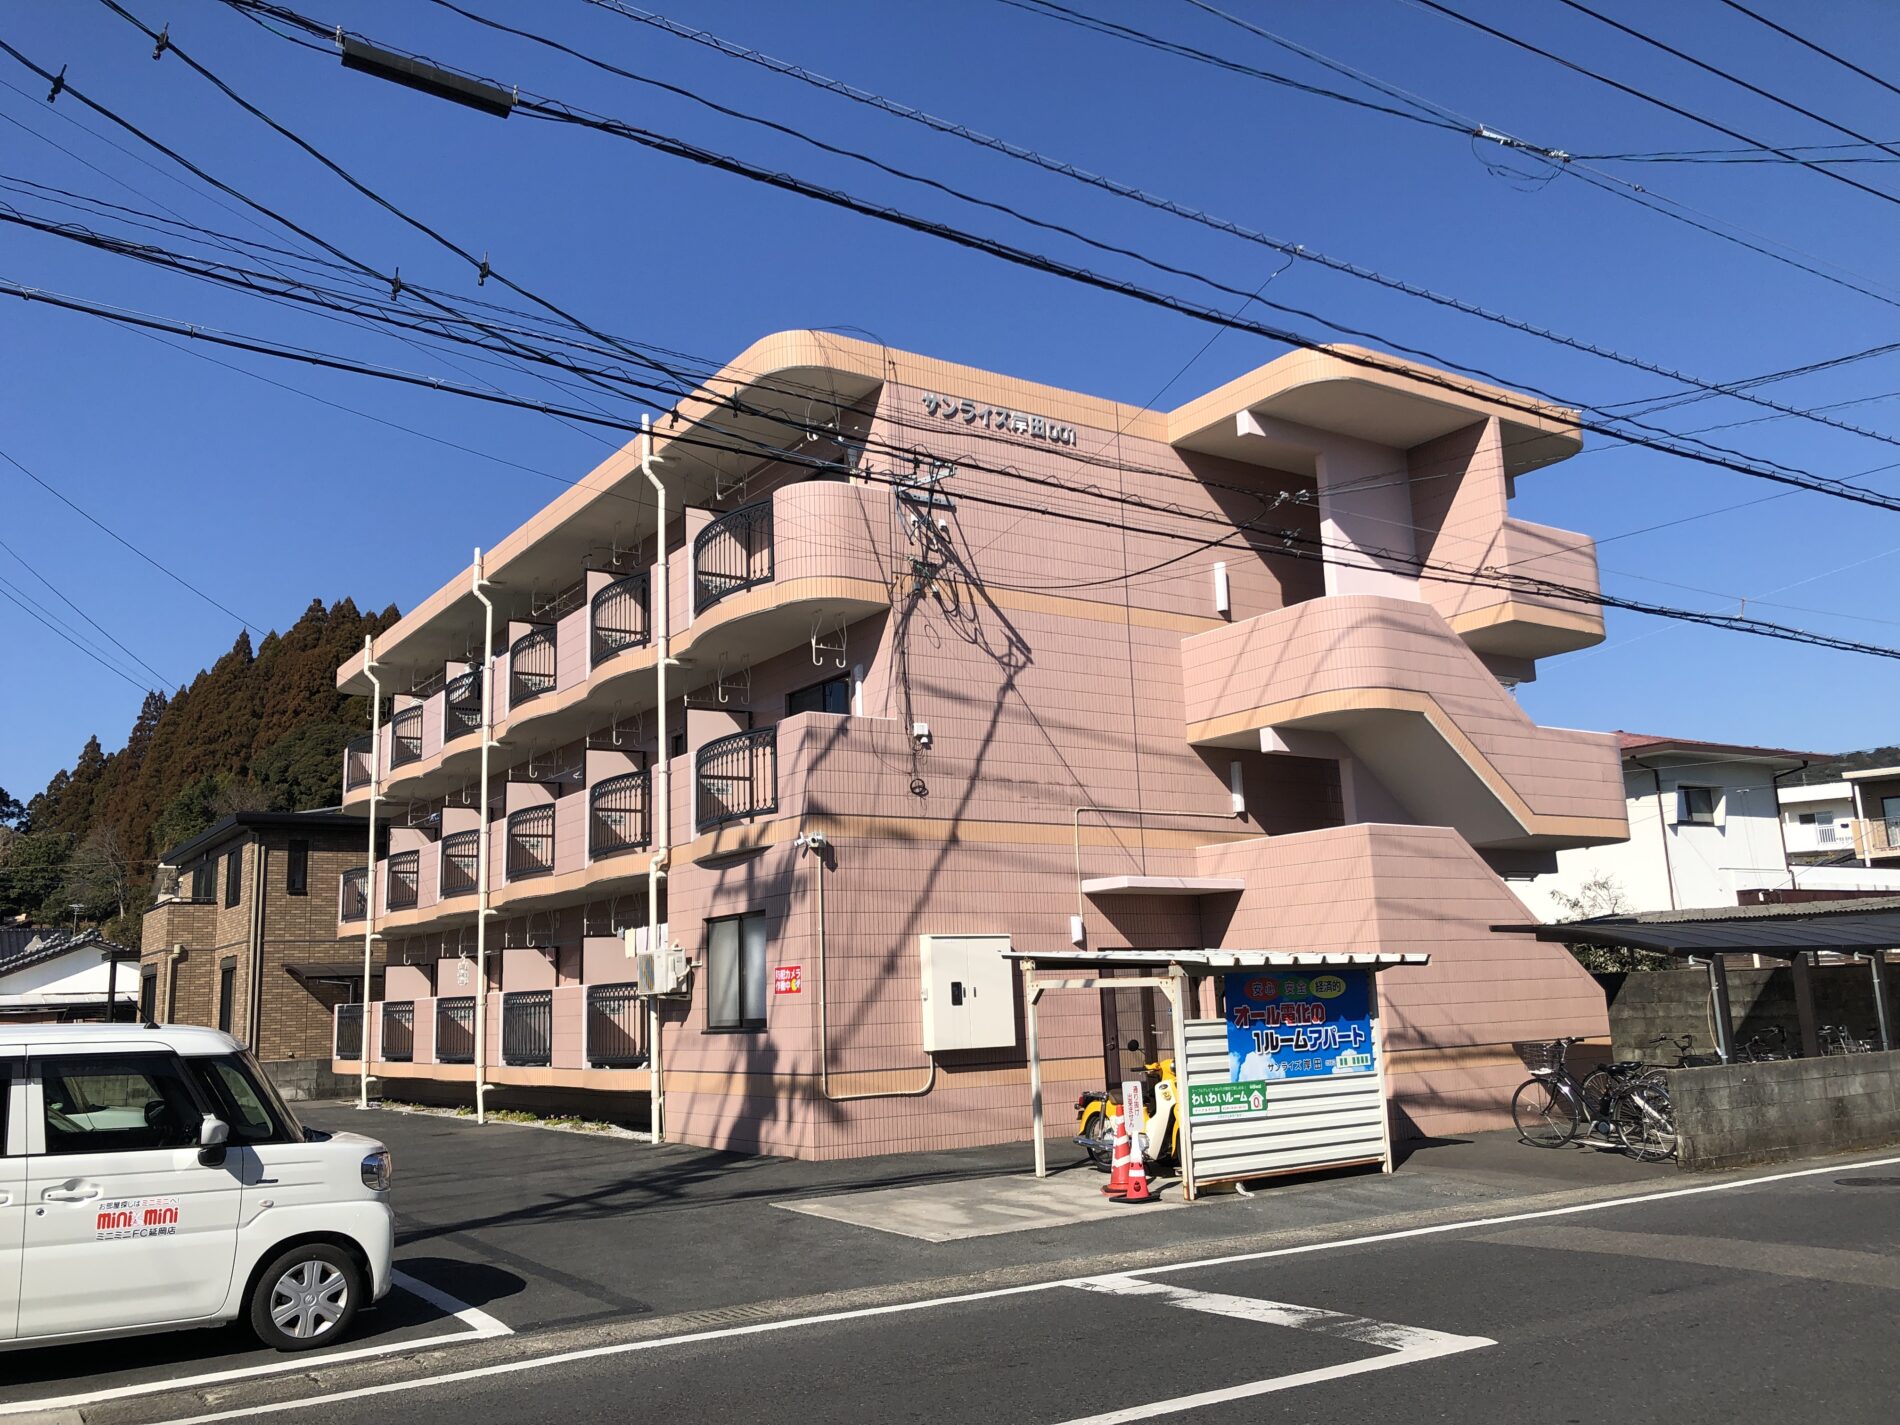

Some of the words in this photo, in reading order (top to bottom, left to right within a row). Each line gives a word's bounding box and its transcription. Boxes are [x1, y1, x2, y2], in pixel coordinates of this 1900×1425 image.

[1251, 981, 1277, 996] 安心
[1283, 980, 1308, 995] 安全
[1314, 980, 1342, 993] 経済的
[1234, 1002, 1326, 1028] オール電化の
[1252, 1025, 1366, 1055] 1ルームアパート
[1191, 1091, 1248, 1106] わいわいルーム
[96, 1211, 134, 1230] mini
[143, 1207, 179, 1226] mini
[96, 1226, 176, 1241] ミニミニFC延岡店
